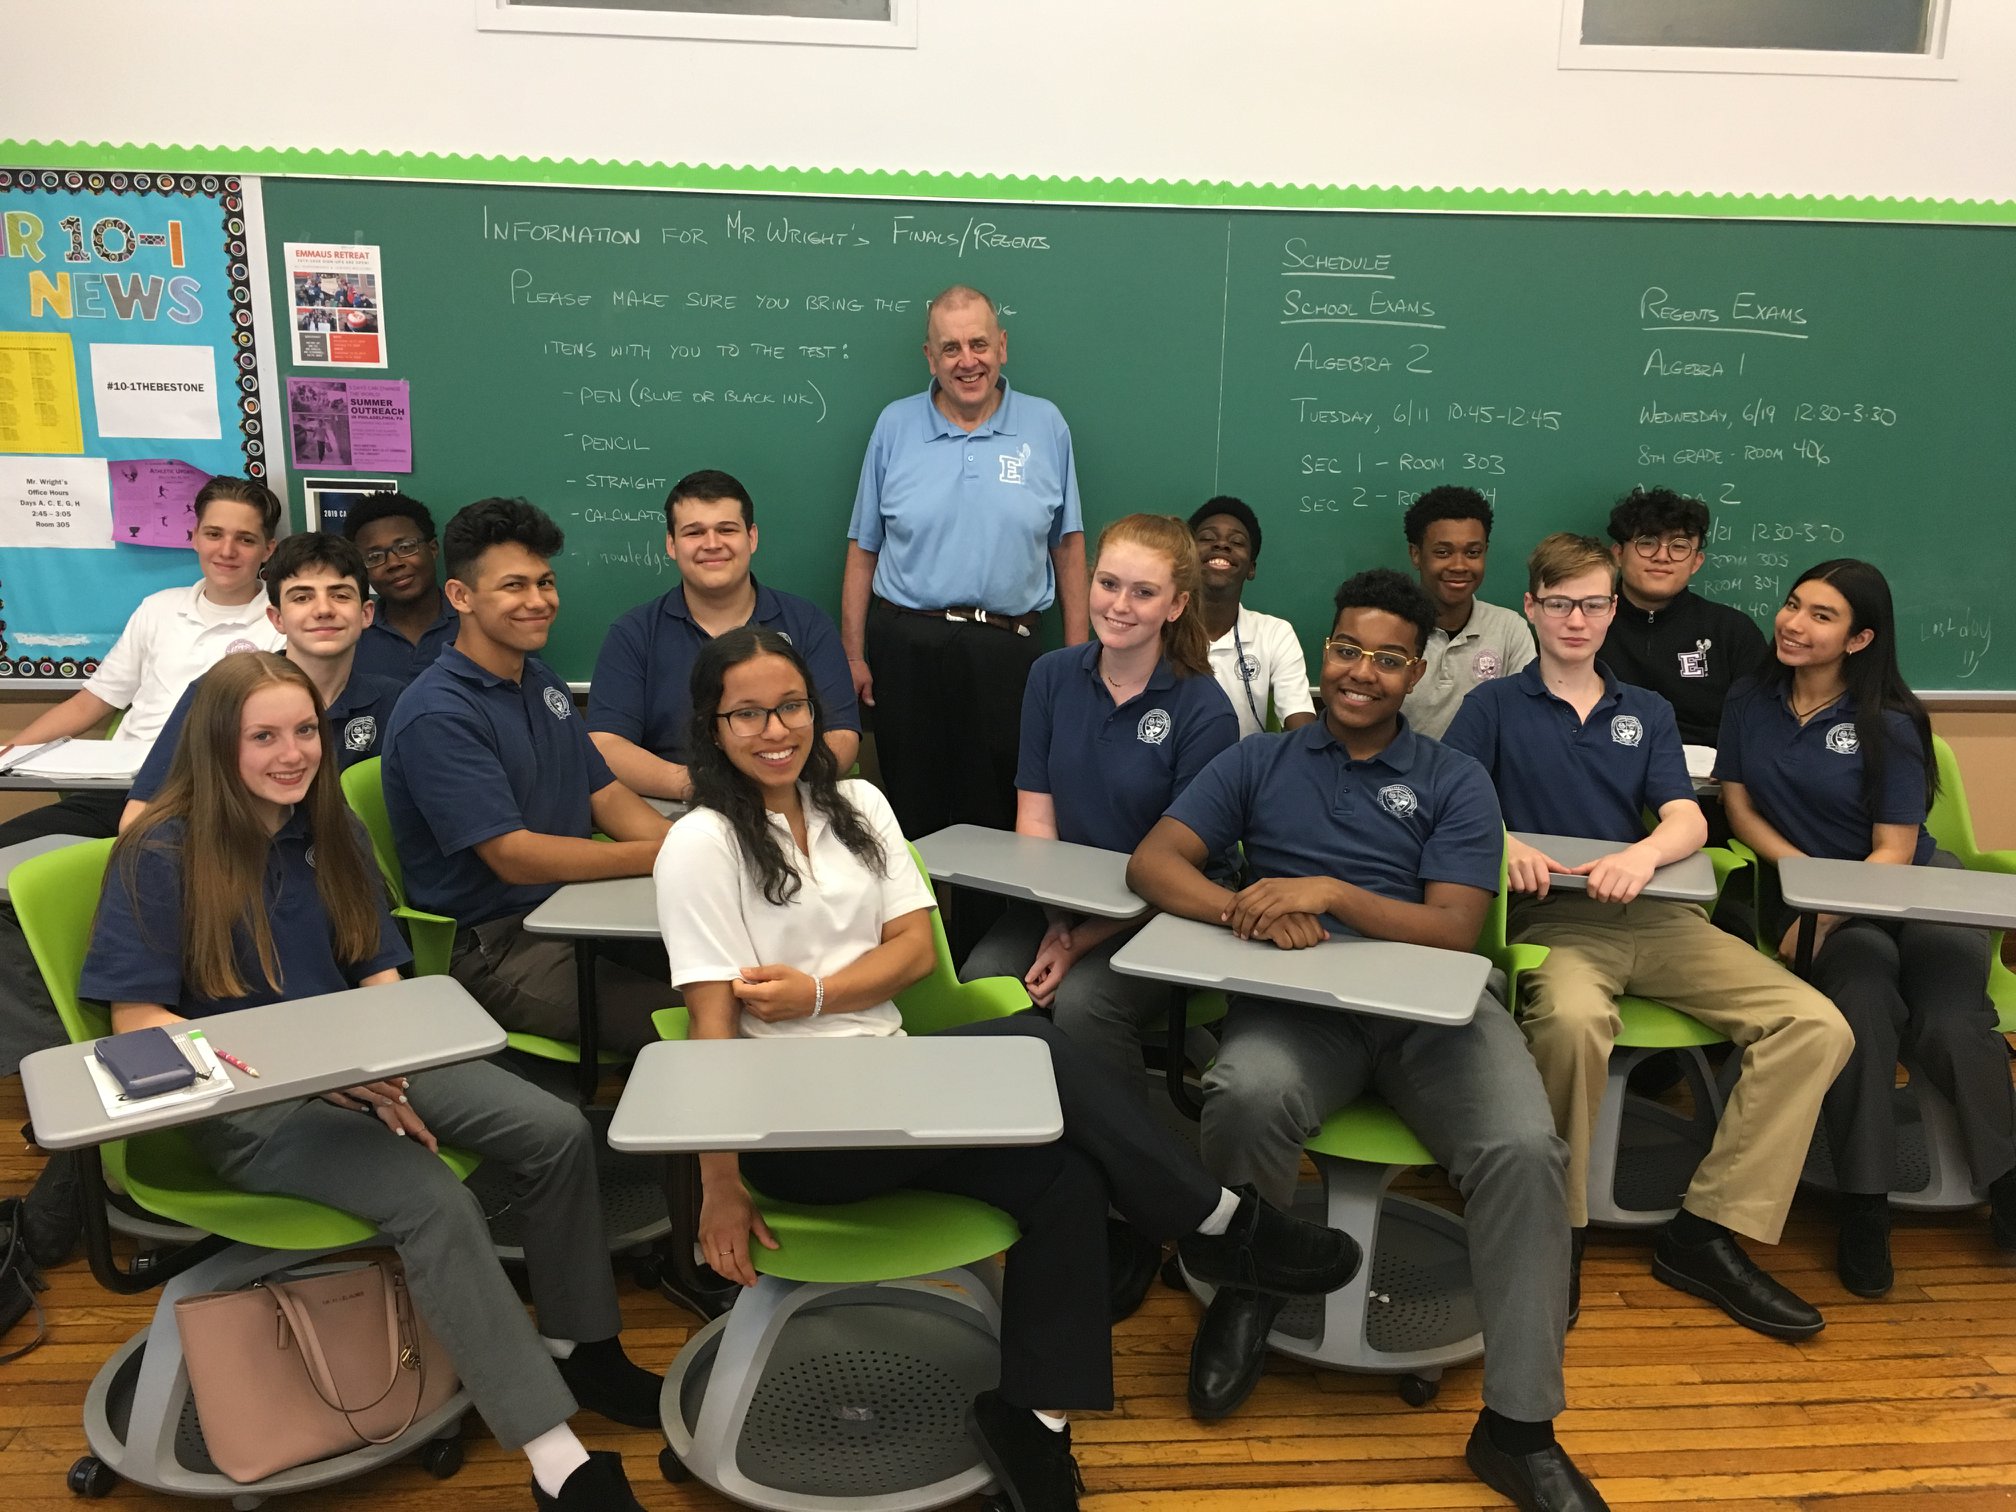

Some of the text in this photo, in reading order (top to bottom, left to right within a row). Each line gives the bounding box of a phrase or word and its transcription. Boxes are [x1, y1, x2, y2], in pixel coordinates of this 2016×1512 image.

[483, 205, 640, 245] INFORMATION
[661, 227, 708, 244] FOR
[766, 217, 871, 247] WRIGHT'S
[295, 250, 370, 260] EMMAUS RETREAT
[1282, 237, 1392, 271] SCHEDULE
[28, 270, 204, 325] NEWS
[511, 268, 592, 305] PLEASE
[613, 290, 670, 308] MAKE
[685, 292, 737, 309] SURE
[756, 296, 790, 310] YOU
[806, 295, 865, 312] BRING
[875, 298, 911, 312] THE
[1282, 289, 1436, 317] SCHOOL EXAMS
[1640, 286, 1807, 324] REGENTS EXAMS
[544, 341, 849, 359] ITEMS WITH YOU TO THE TEST:
[1294, 342, 1433, 374] ALGEBRA 2
[1643, 348, 1723, 377] ALGEBRA
[107, 381, 205, 392] #10-1THEBESTONE
[693, 391, 715, 403] OR
[724, 389, 775, 403] BLACK
[350, 398, 393, 407] SUMMER
[350, 407, 405, 416] OUTREACH
[1639, 400, 1733, 429] WEDNESDAY,
[1742, 397, 1776, 427] 6/19
[1290, 397, 1380, 434] TUESDAY,
[1393, 400, 1429, 426] 6/11
[581, 435, 650, 452] PENCIL
[1638, 444, 1665, 466] 8TH
[1673, 449, 1724, 465] GRADE
[1744, 445, 1783, 461] ROOM
[1793, 438, 1831, 467] 406
[999, 454, 1022, 485] E
[1301, 454, 1342, 475] SEC
[1400, 453, 1445, 471] ROOM
[1462, 453, 1506, 475] 303
[40, 478, 68, 486] Wright's
[585, 474, 666, 489] STRAIGHT
[1719, 482, 1742, 504] 2
[1299, 496, 1340, 512] SEC
[1352, 487, 1368, 507] 2
[323, 509, 338, 518] 2019
[584, 508, 668, 523] CALCULATO
[587, 540, 670, 575] nowledge
[1704, 578, 1742, 596] ROOM
[1677, 651, 1705, 678] E
